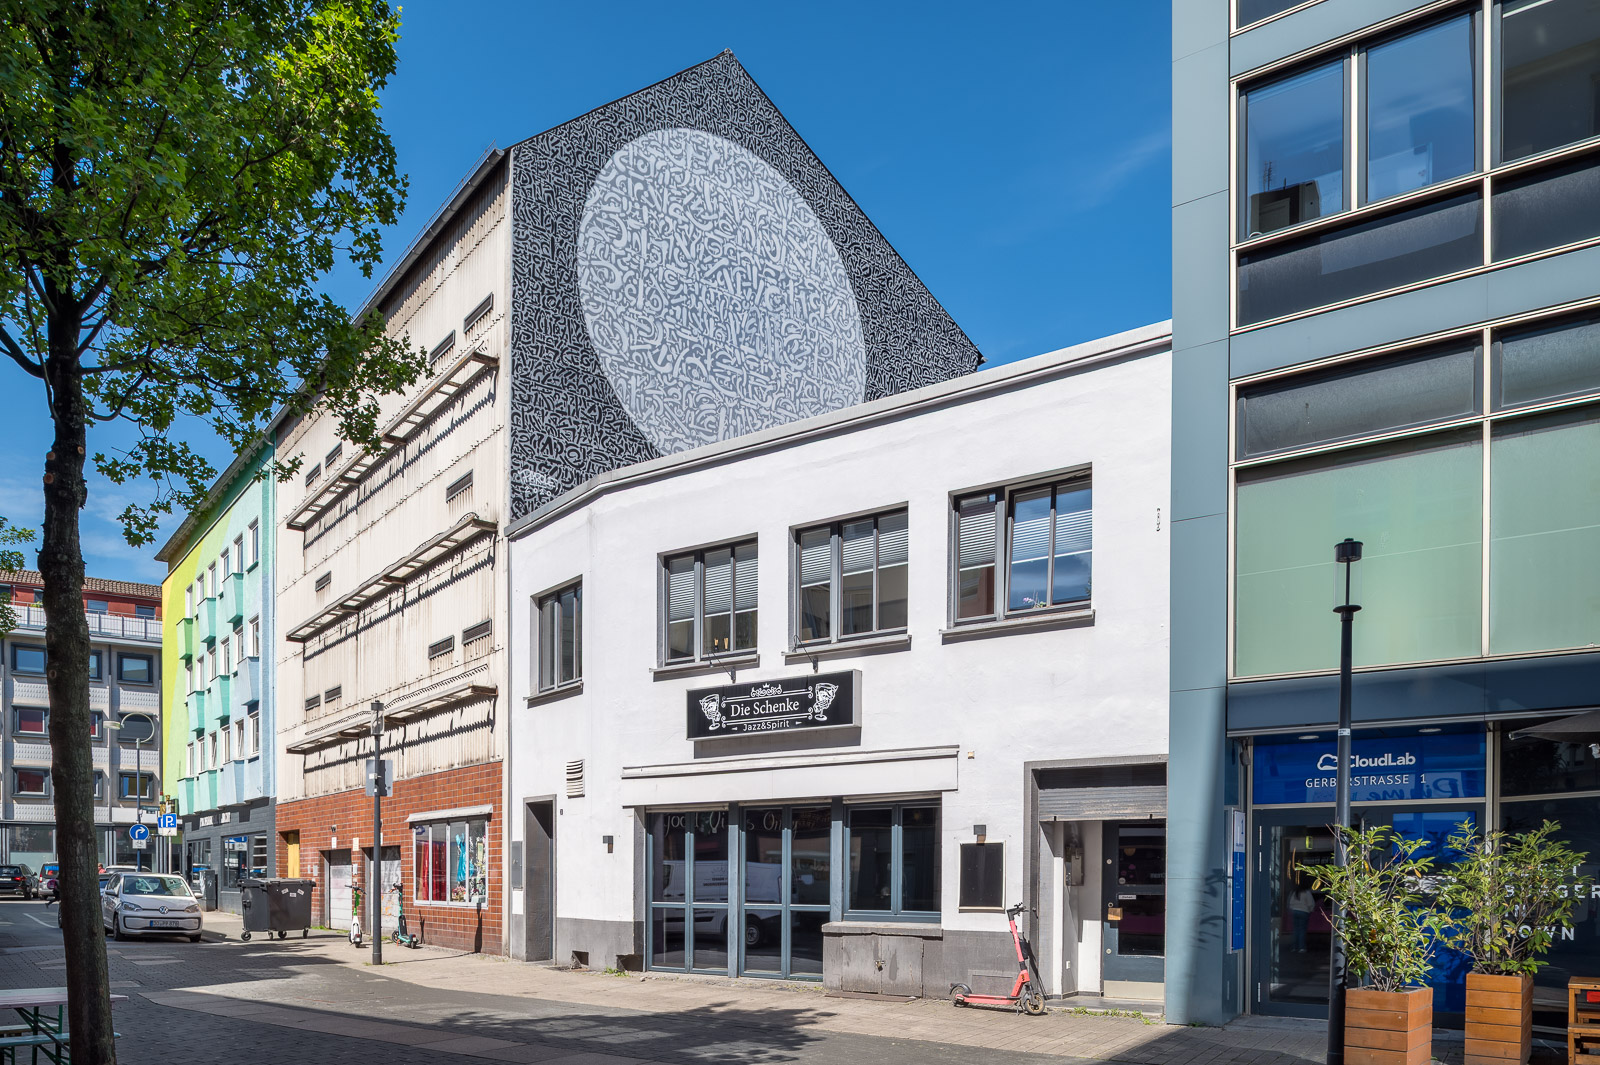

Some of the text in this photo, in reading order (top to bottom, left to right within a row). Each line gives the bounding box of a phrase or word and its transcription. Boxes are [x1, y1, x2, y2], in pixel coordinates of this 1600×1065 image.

[730, 697, 800, 717] Die Schenke
[742, 719, 790, 732] Jazz&Spirit
[1305, 775, 1409, 788] GERBSTRASSE
[1420, 773, 1427, 784] 1
[763, 811, 798, 840] Ony
